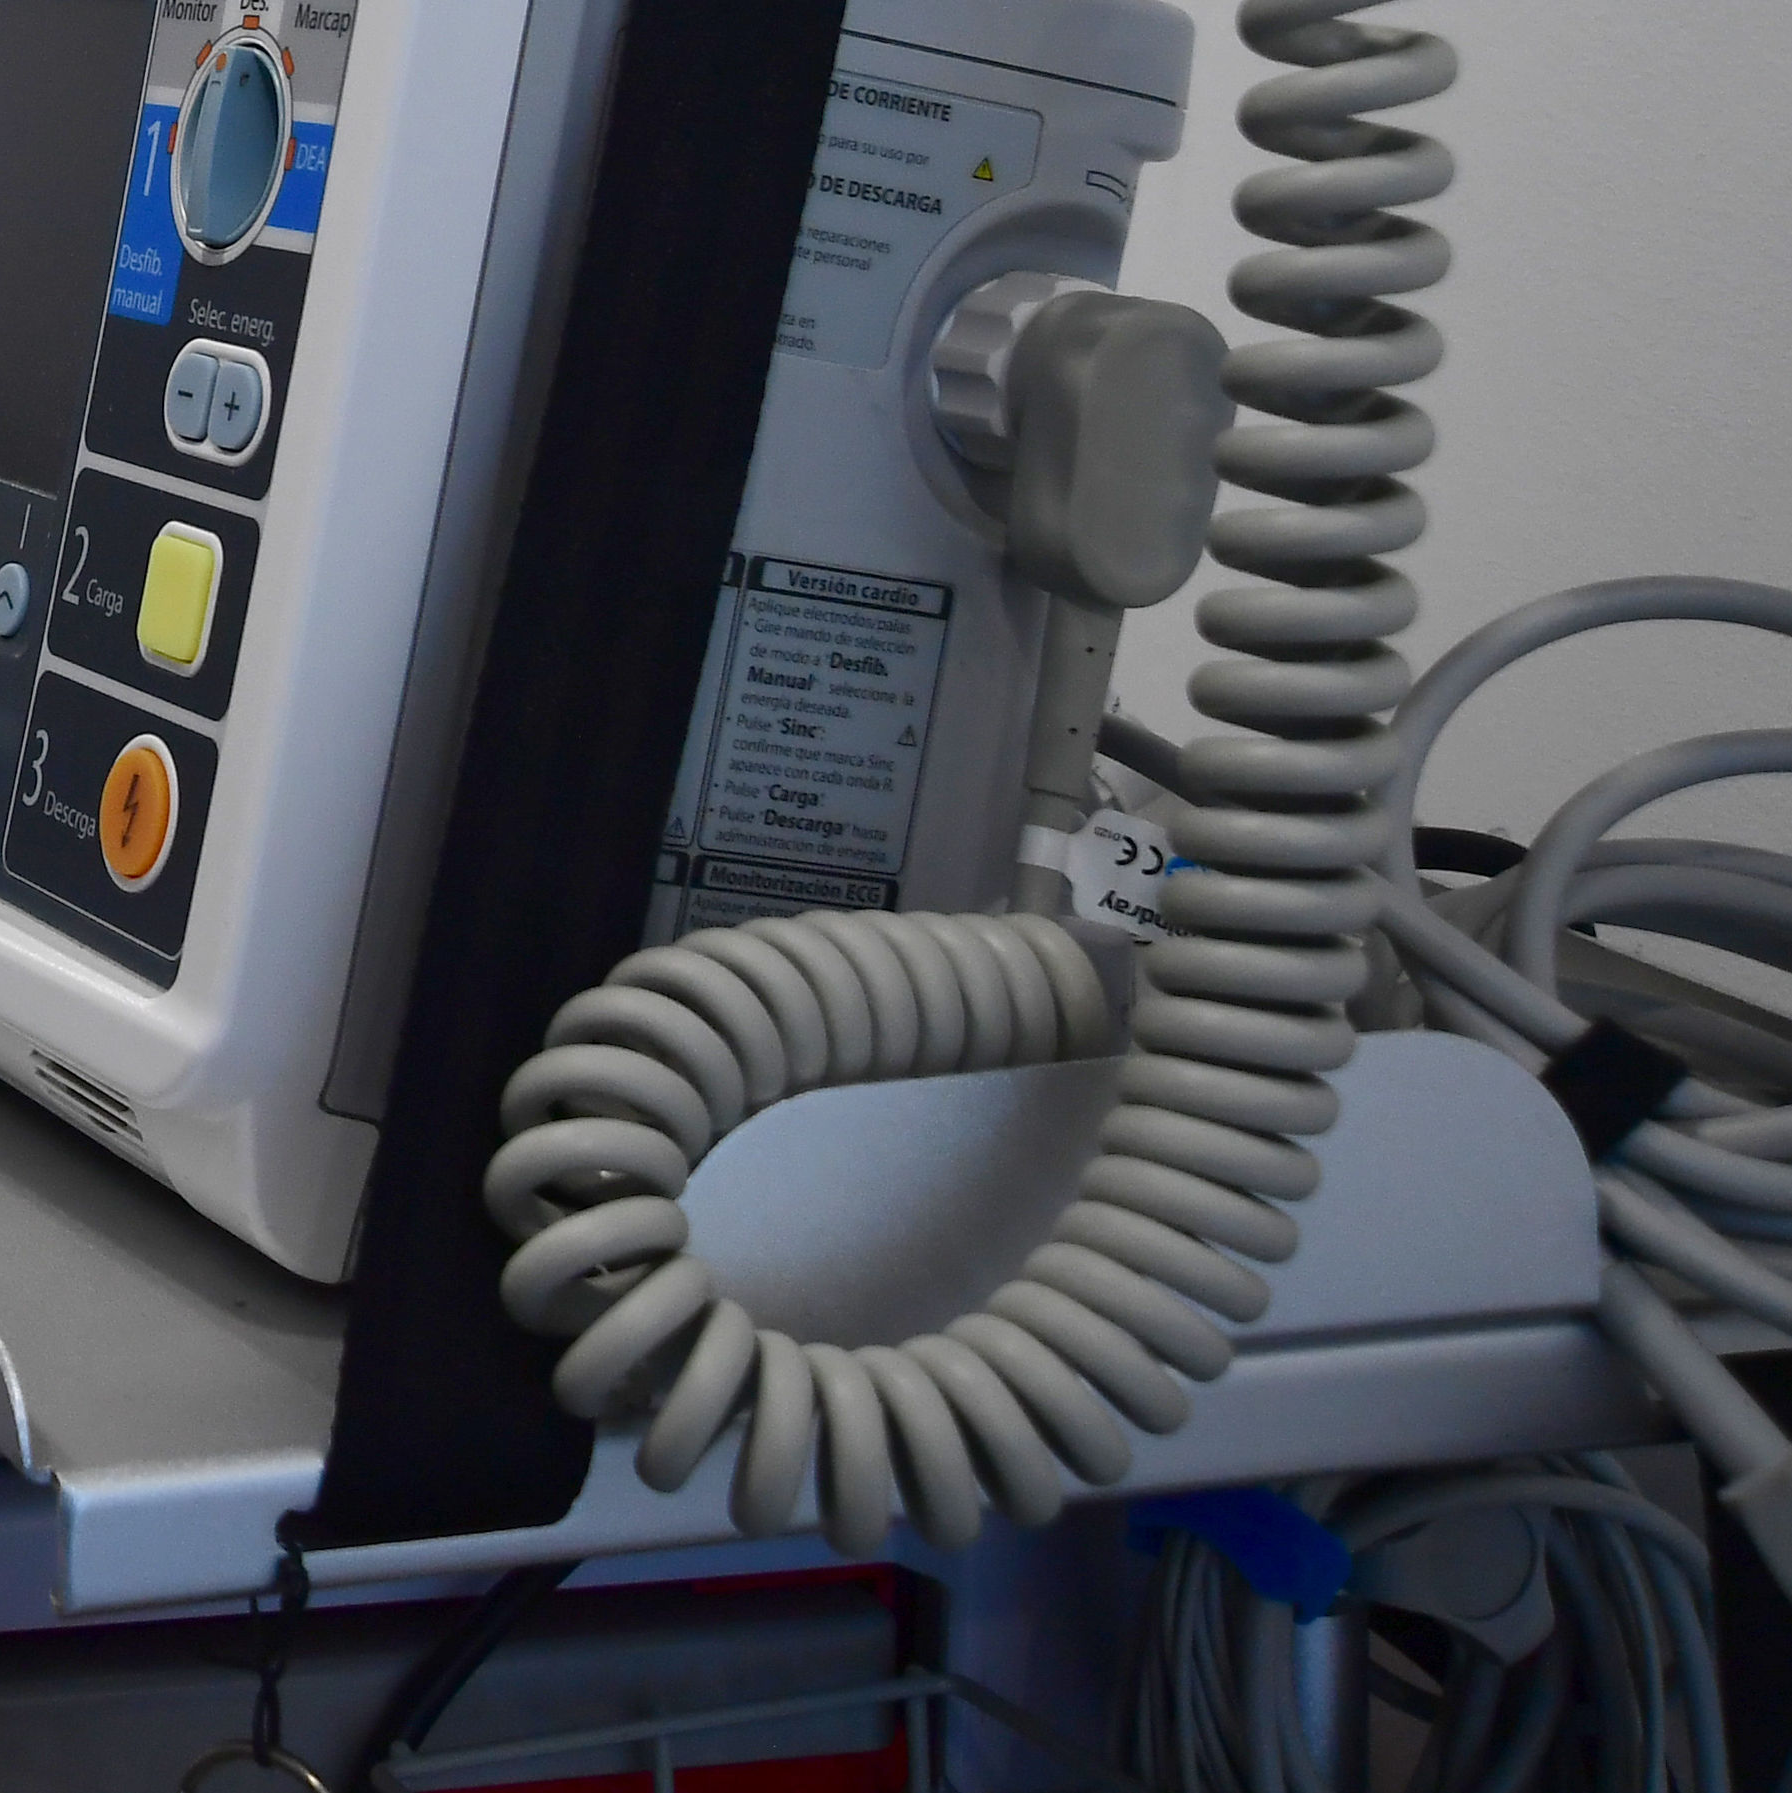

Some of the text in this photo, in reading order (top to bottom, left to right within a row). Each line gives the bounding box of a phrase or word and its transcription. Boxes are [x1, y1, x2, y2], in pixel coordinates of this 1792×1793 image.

[294, 2, 352, 39] Marcap
[854, 86, 952, 123] CORRIENTE
[143, 119, 162, 197] 1
[294, 142, 327, 172] DEA
[820, 174, 942, 216] DE DESCARGA
[118, 243, 163, 277] Desfib.
[807, 227, 891, 255] reparaciones
[813, 250, 871, 272] personal
[112, 287, 163, 316] manual
[188, 297, 275, 348] Selec. energ.
[61, 525, 124, 618] 2 Carga
[788, 569, 920, 607] Versión cardio
[21, 728, 96, 840] 3 Descrga
[1115, 835, 1164, 875] CE
[708, 864, 882, 904] Monitorización ECG
